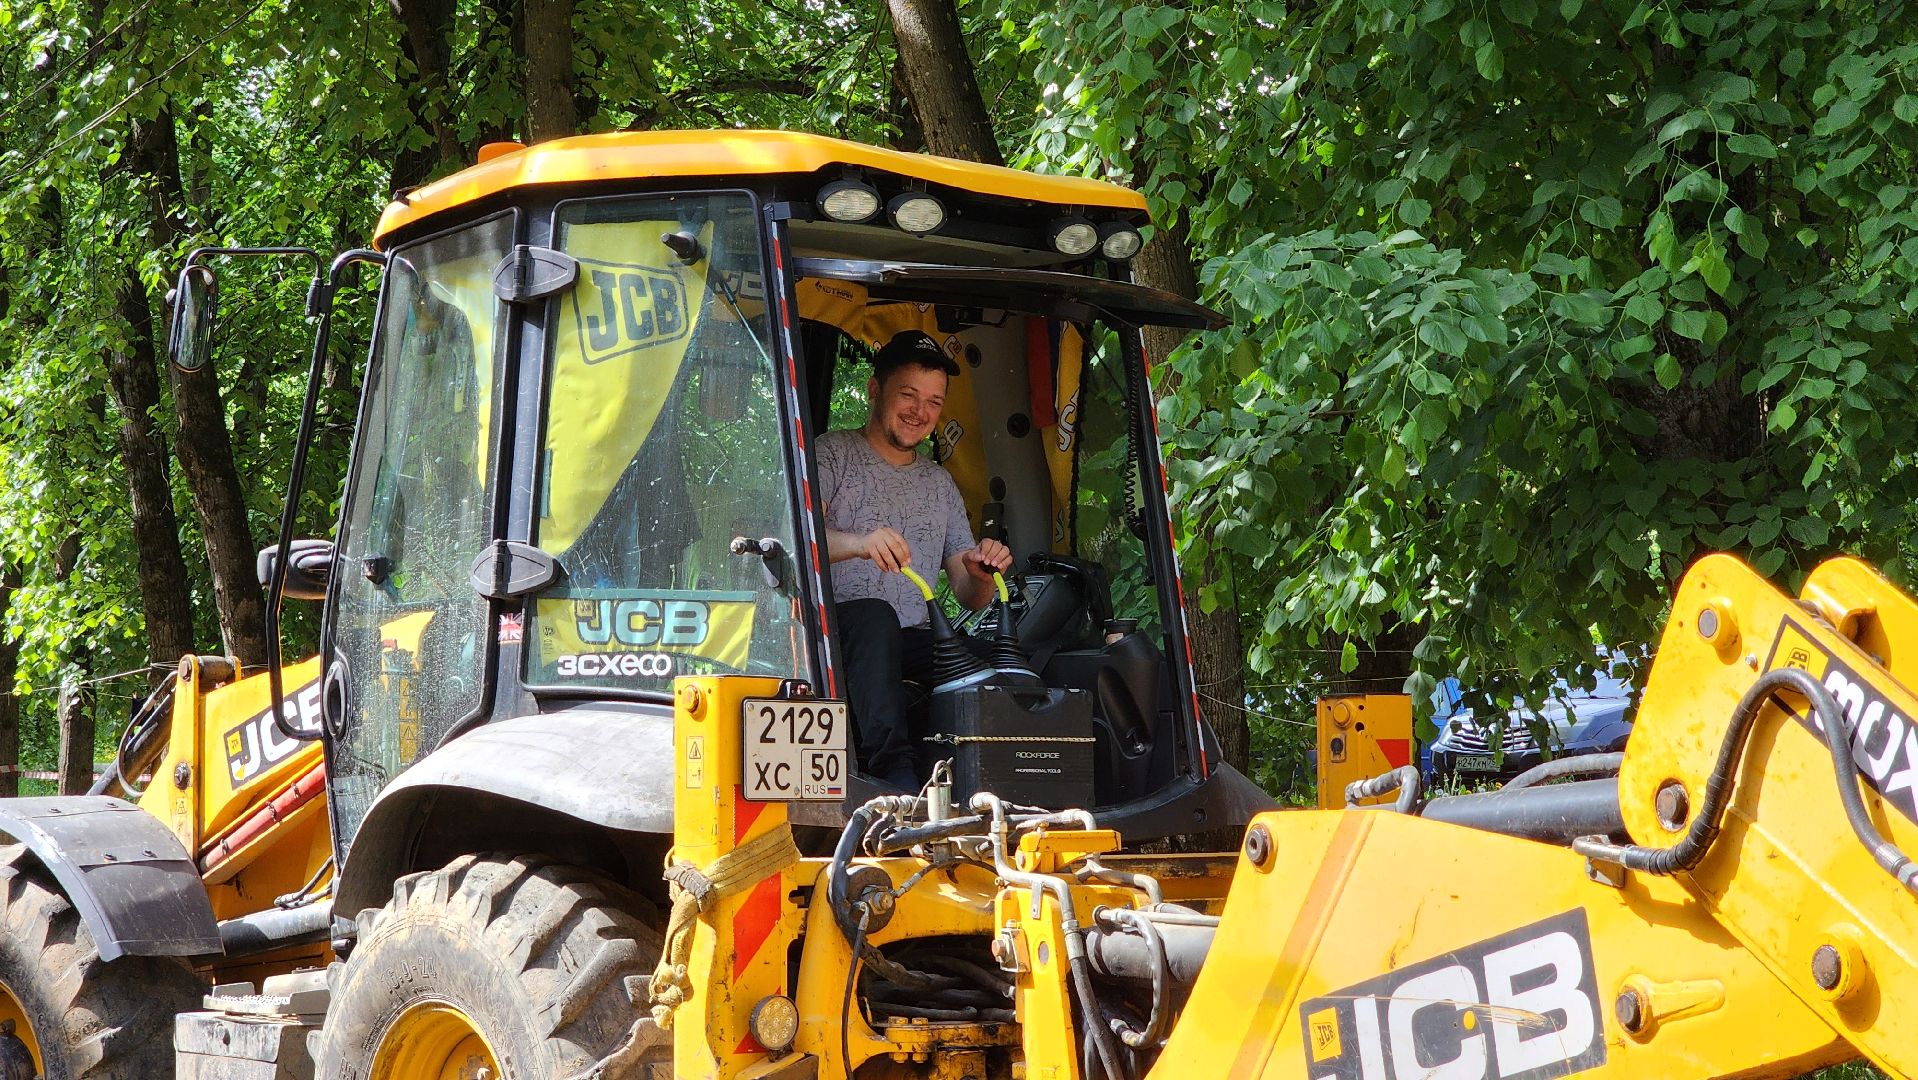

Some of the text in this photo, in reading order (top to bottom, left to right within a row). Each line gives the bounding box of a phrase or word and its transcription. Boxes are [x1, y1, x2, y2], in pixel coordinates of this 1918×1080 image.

[586, 269, 681, 352] JCB
[576, 599, 709, 645] JCB
[759, 706, 834, 745] 2129
[811, 754, 840, 782] 50
[1015, 751, 1061, 759] ROCKFORCE
[804, 785, 826, 794] RUS
[1317, 931, 1595, 1080] JCB
